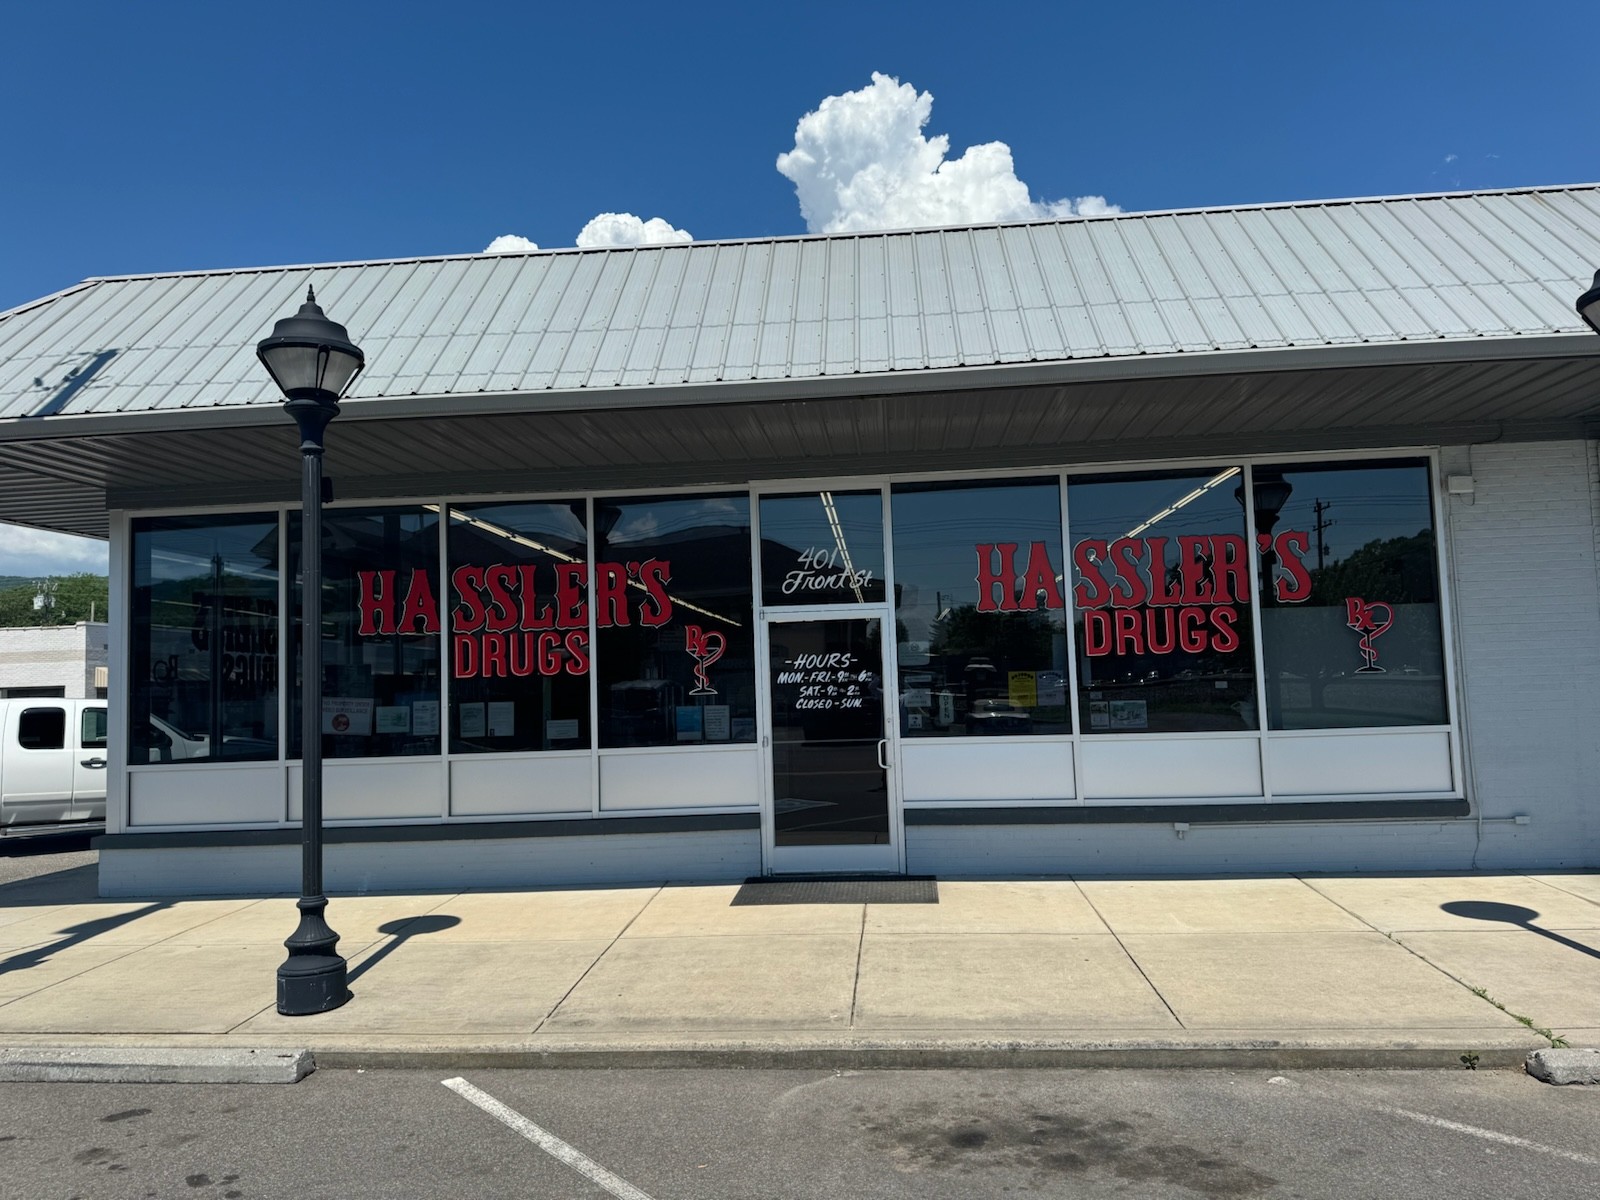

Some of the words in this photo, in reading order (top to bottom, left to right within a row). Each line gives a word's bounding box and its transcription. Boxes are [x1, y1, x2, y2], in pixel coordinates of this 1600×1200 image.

[781, 567, 849, 595] Front
[797, 546, 839, 570] 401
[975, 529, 1312, 613] HASSLER'S
[357, 557, 673, 636] HASSLER'S
[453, 630, 590, 678] DRUGS
[1084, 606, 1239, 657] DRUGS
